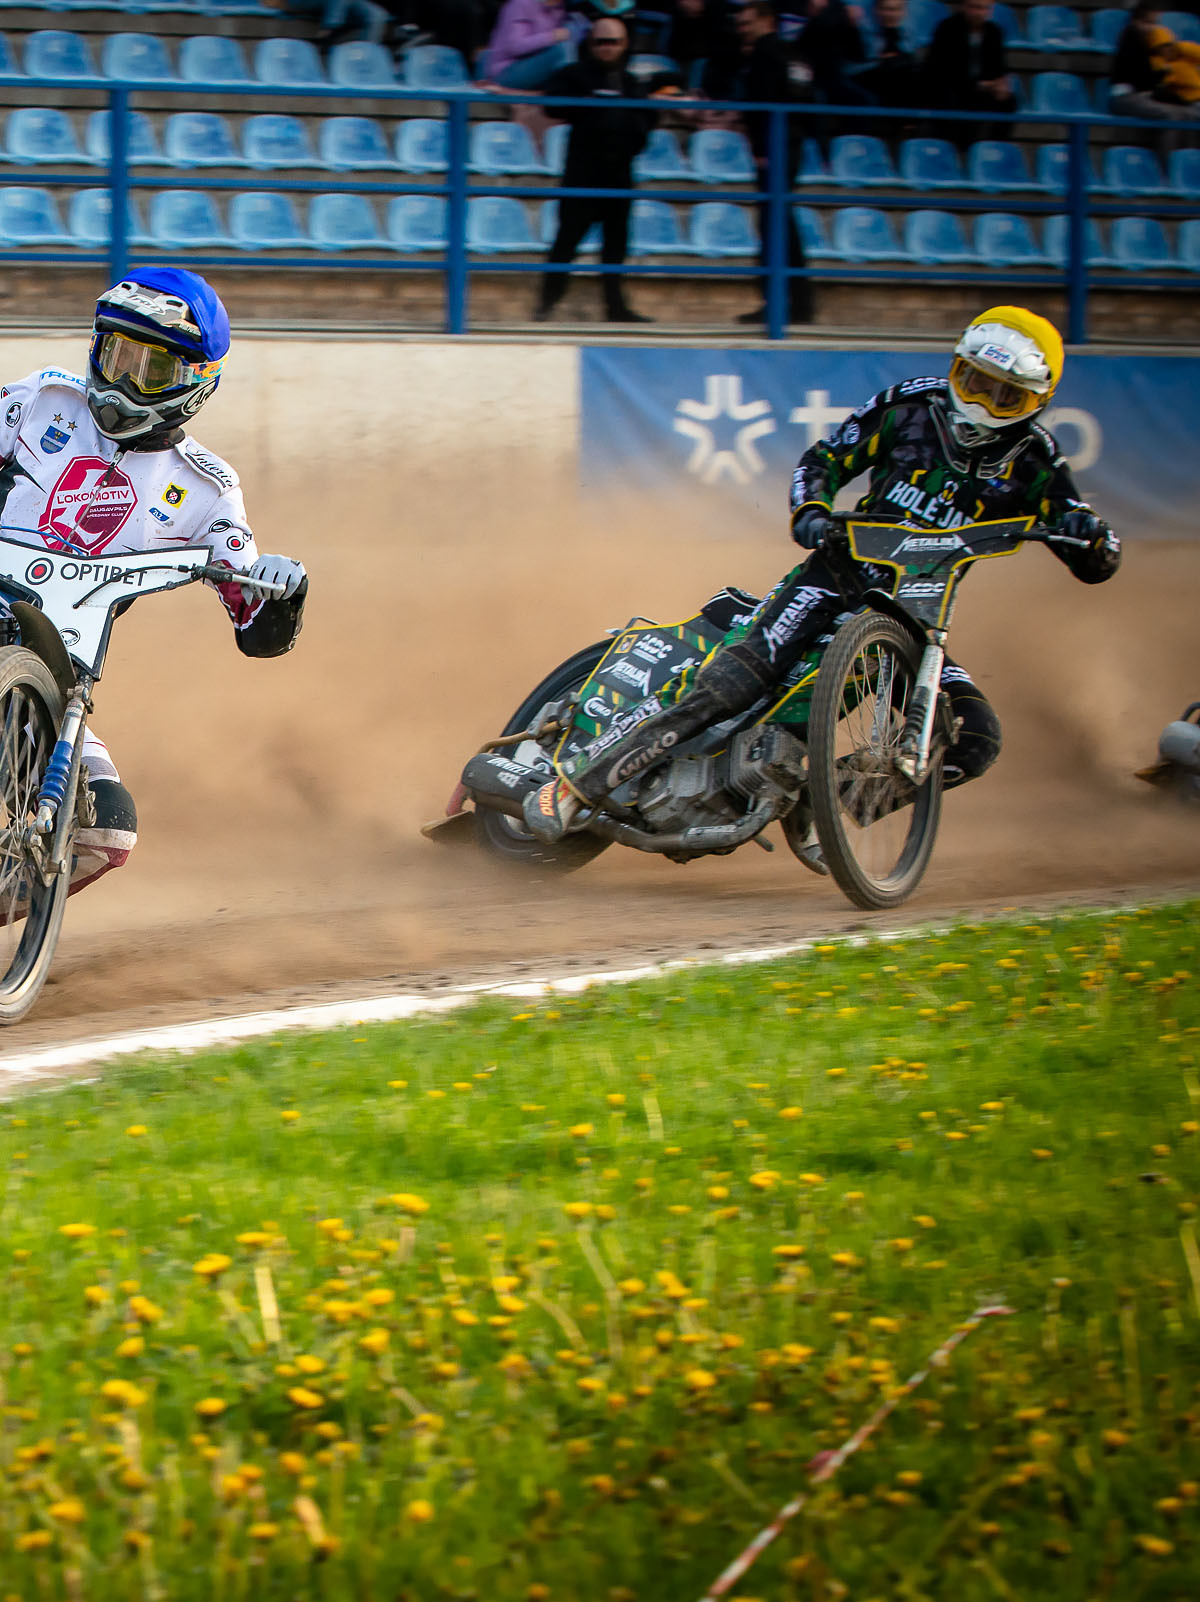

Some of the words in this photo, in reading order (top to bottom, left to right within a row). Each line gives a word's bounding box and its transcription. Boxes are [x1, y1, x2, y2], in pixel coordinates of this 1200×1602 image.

[56, 489, 130, 505] LOKOMOTIV
[884, 480, 940, 522] HOLE
[889, 533, 975, 558] METALIKA
[60, 562, 148, 587] OPTIBET
[762, 585, 840, 664] METALIKA
